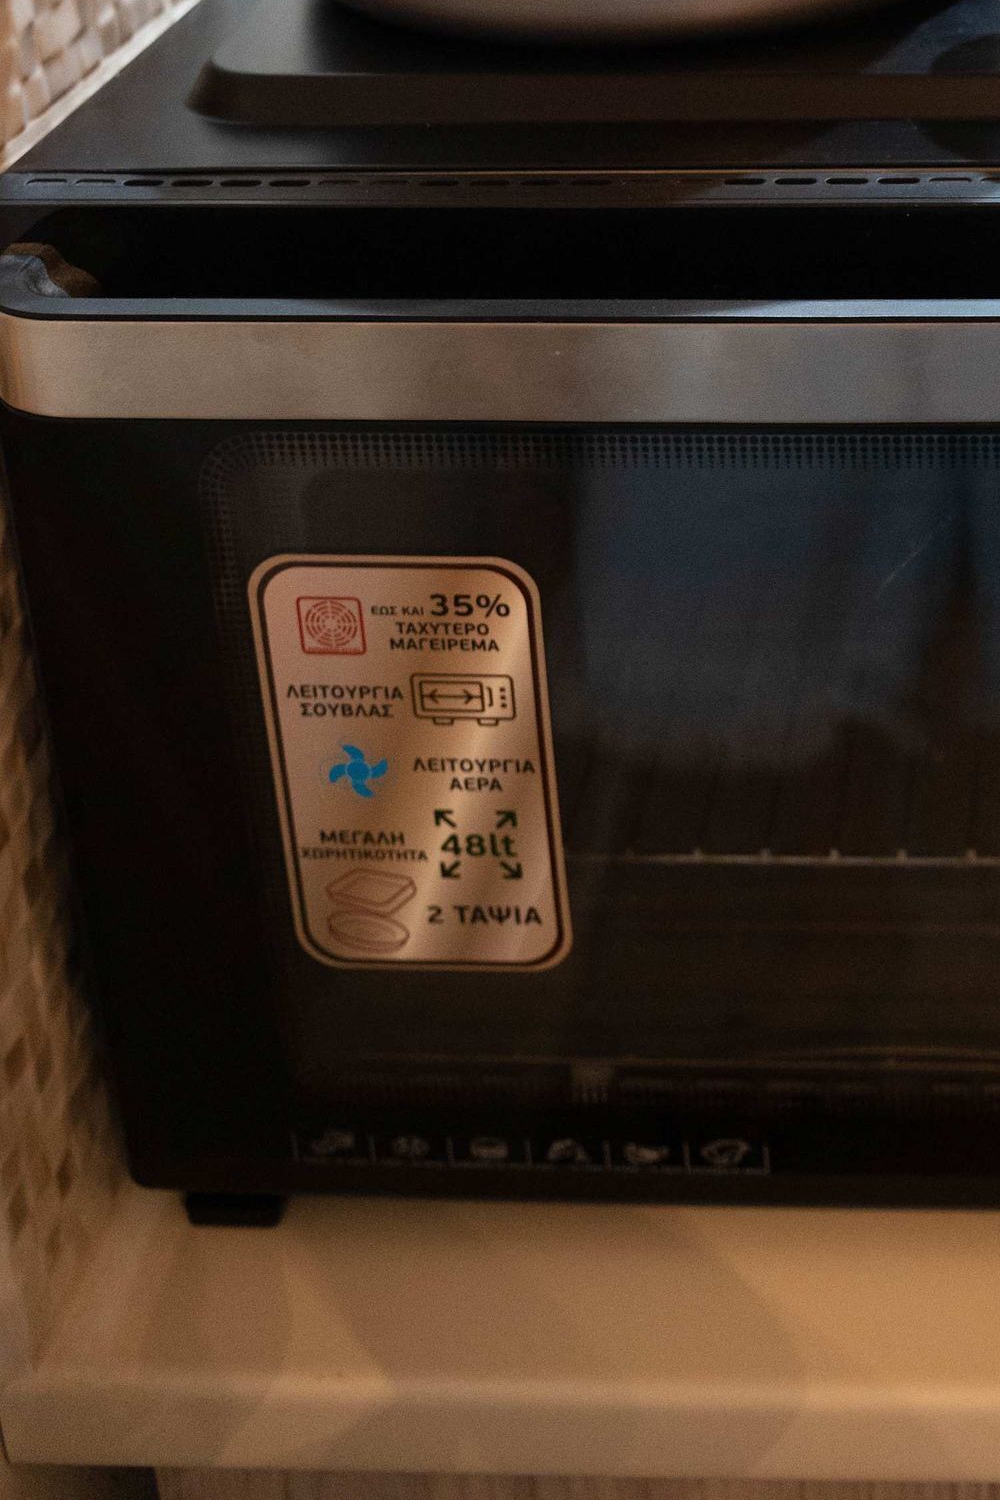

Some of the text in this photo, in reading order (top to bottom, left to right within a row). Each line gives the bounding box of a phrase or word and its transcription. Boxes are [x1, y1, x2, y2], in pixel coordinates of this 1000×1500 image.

[370, 592, 511, 618] ΕΩΣ ΚΑΙ 35%
[395, 621, 490, 636] ΤΑΧΥΤΕΡΟ
[389, 638, 500, 652] ΜΑΓΕΙΡΕΜΑ
[286, 683, 404, 701] ΛΕΙΤΟΥΡΓΙΑ
[299, 703, 394, 718] ΣΟΥΒΛΑΣ
[412, 756, 536, 775] ΛΕΙΤΟΥΡΓΙΑ
[449, 777, 504, 792] ΑΕΡΑ
[319, 829, 406, 846] ΜΕΓΑΛΗ
[428, 904, 543, 926] 2 ΤΑΨΙΑ
